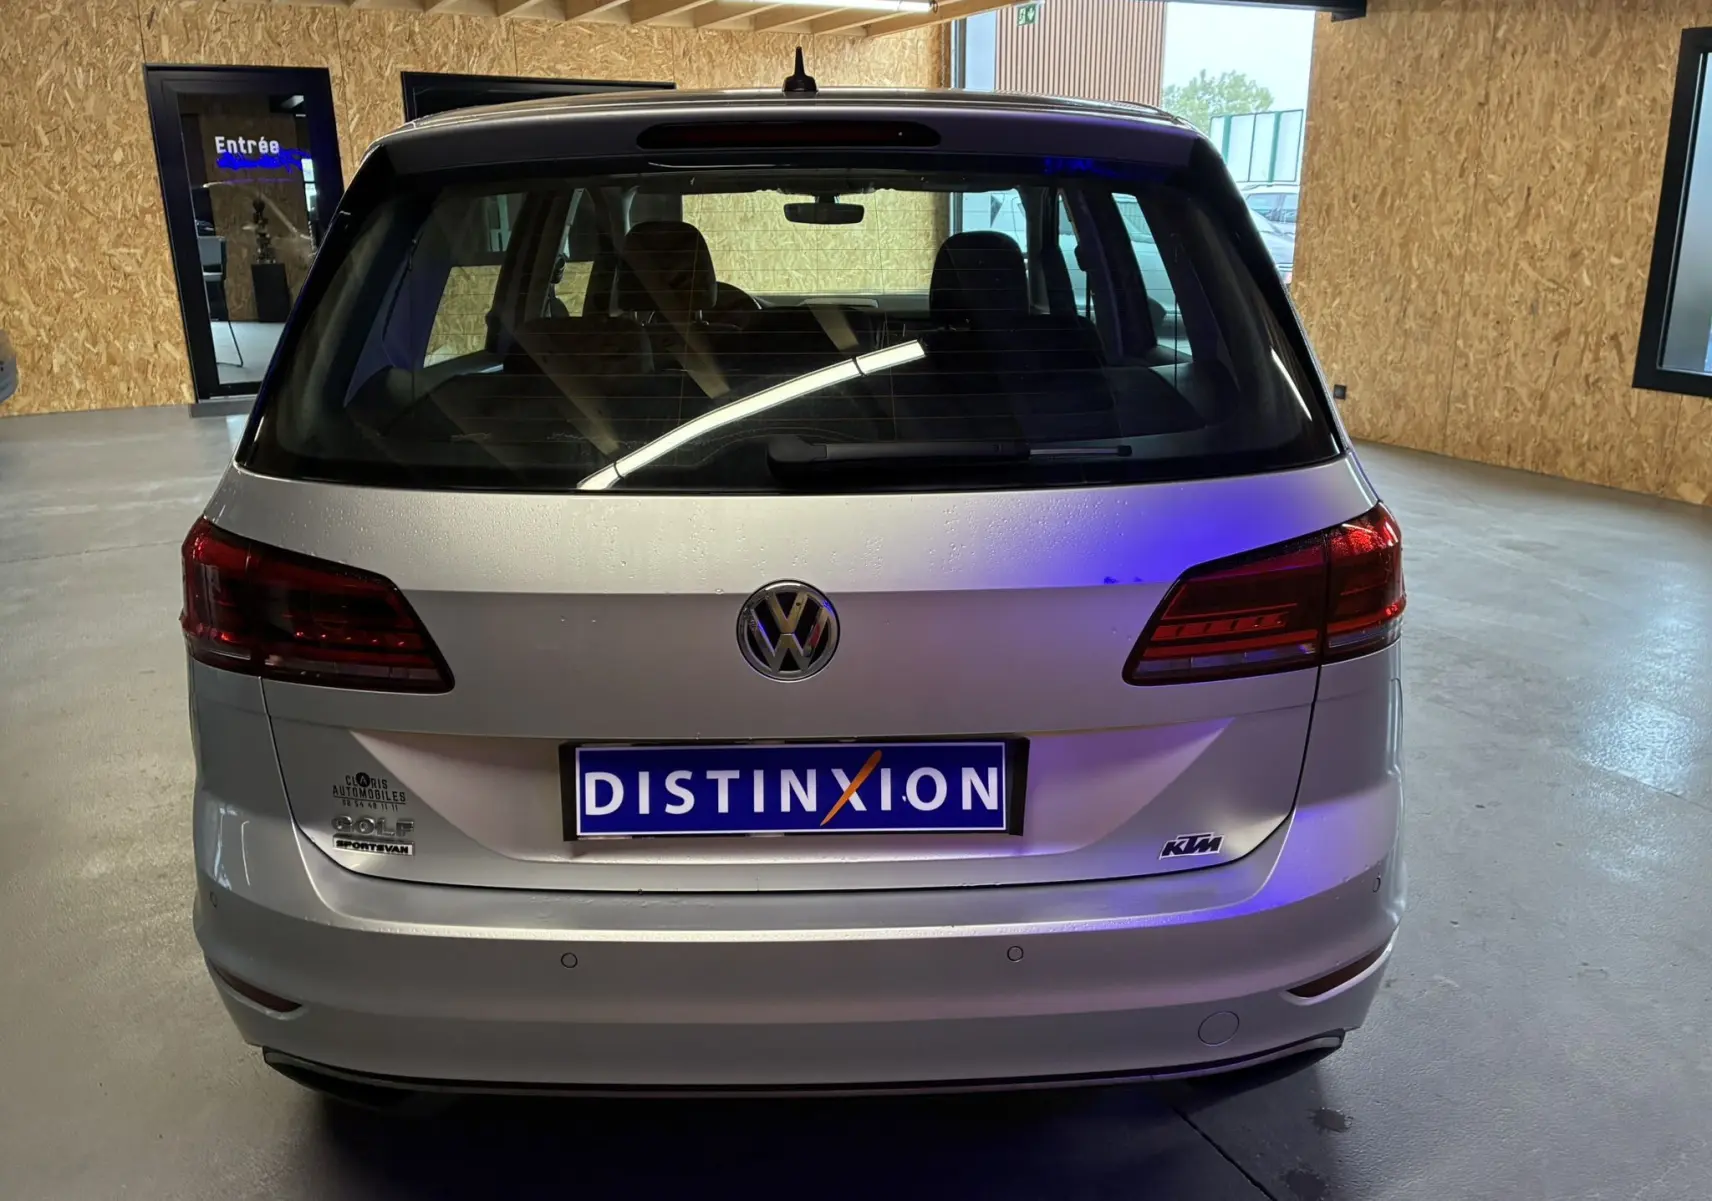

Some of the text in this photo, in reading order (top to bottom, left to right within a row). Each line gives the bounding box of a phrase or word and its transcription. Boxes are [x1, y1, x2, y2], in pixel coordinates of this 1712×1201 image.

[215, 135, 280, 154] Entrée
[332, 785, 406, 802] AUTOMOBILES
[584, 750, 999, 826] DISTINXION
[331, 815, 414, 837] GOLF
[336, 840, 409, 854] SPORTSVAN
[1160, 833, 1223, 857] KTM
